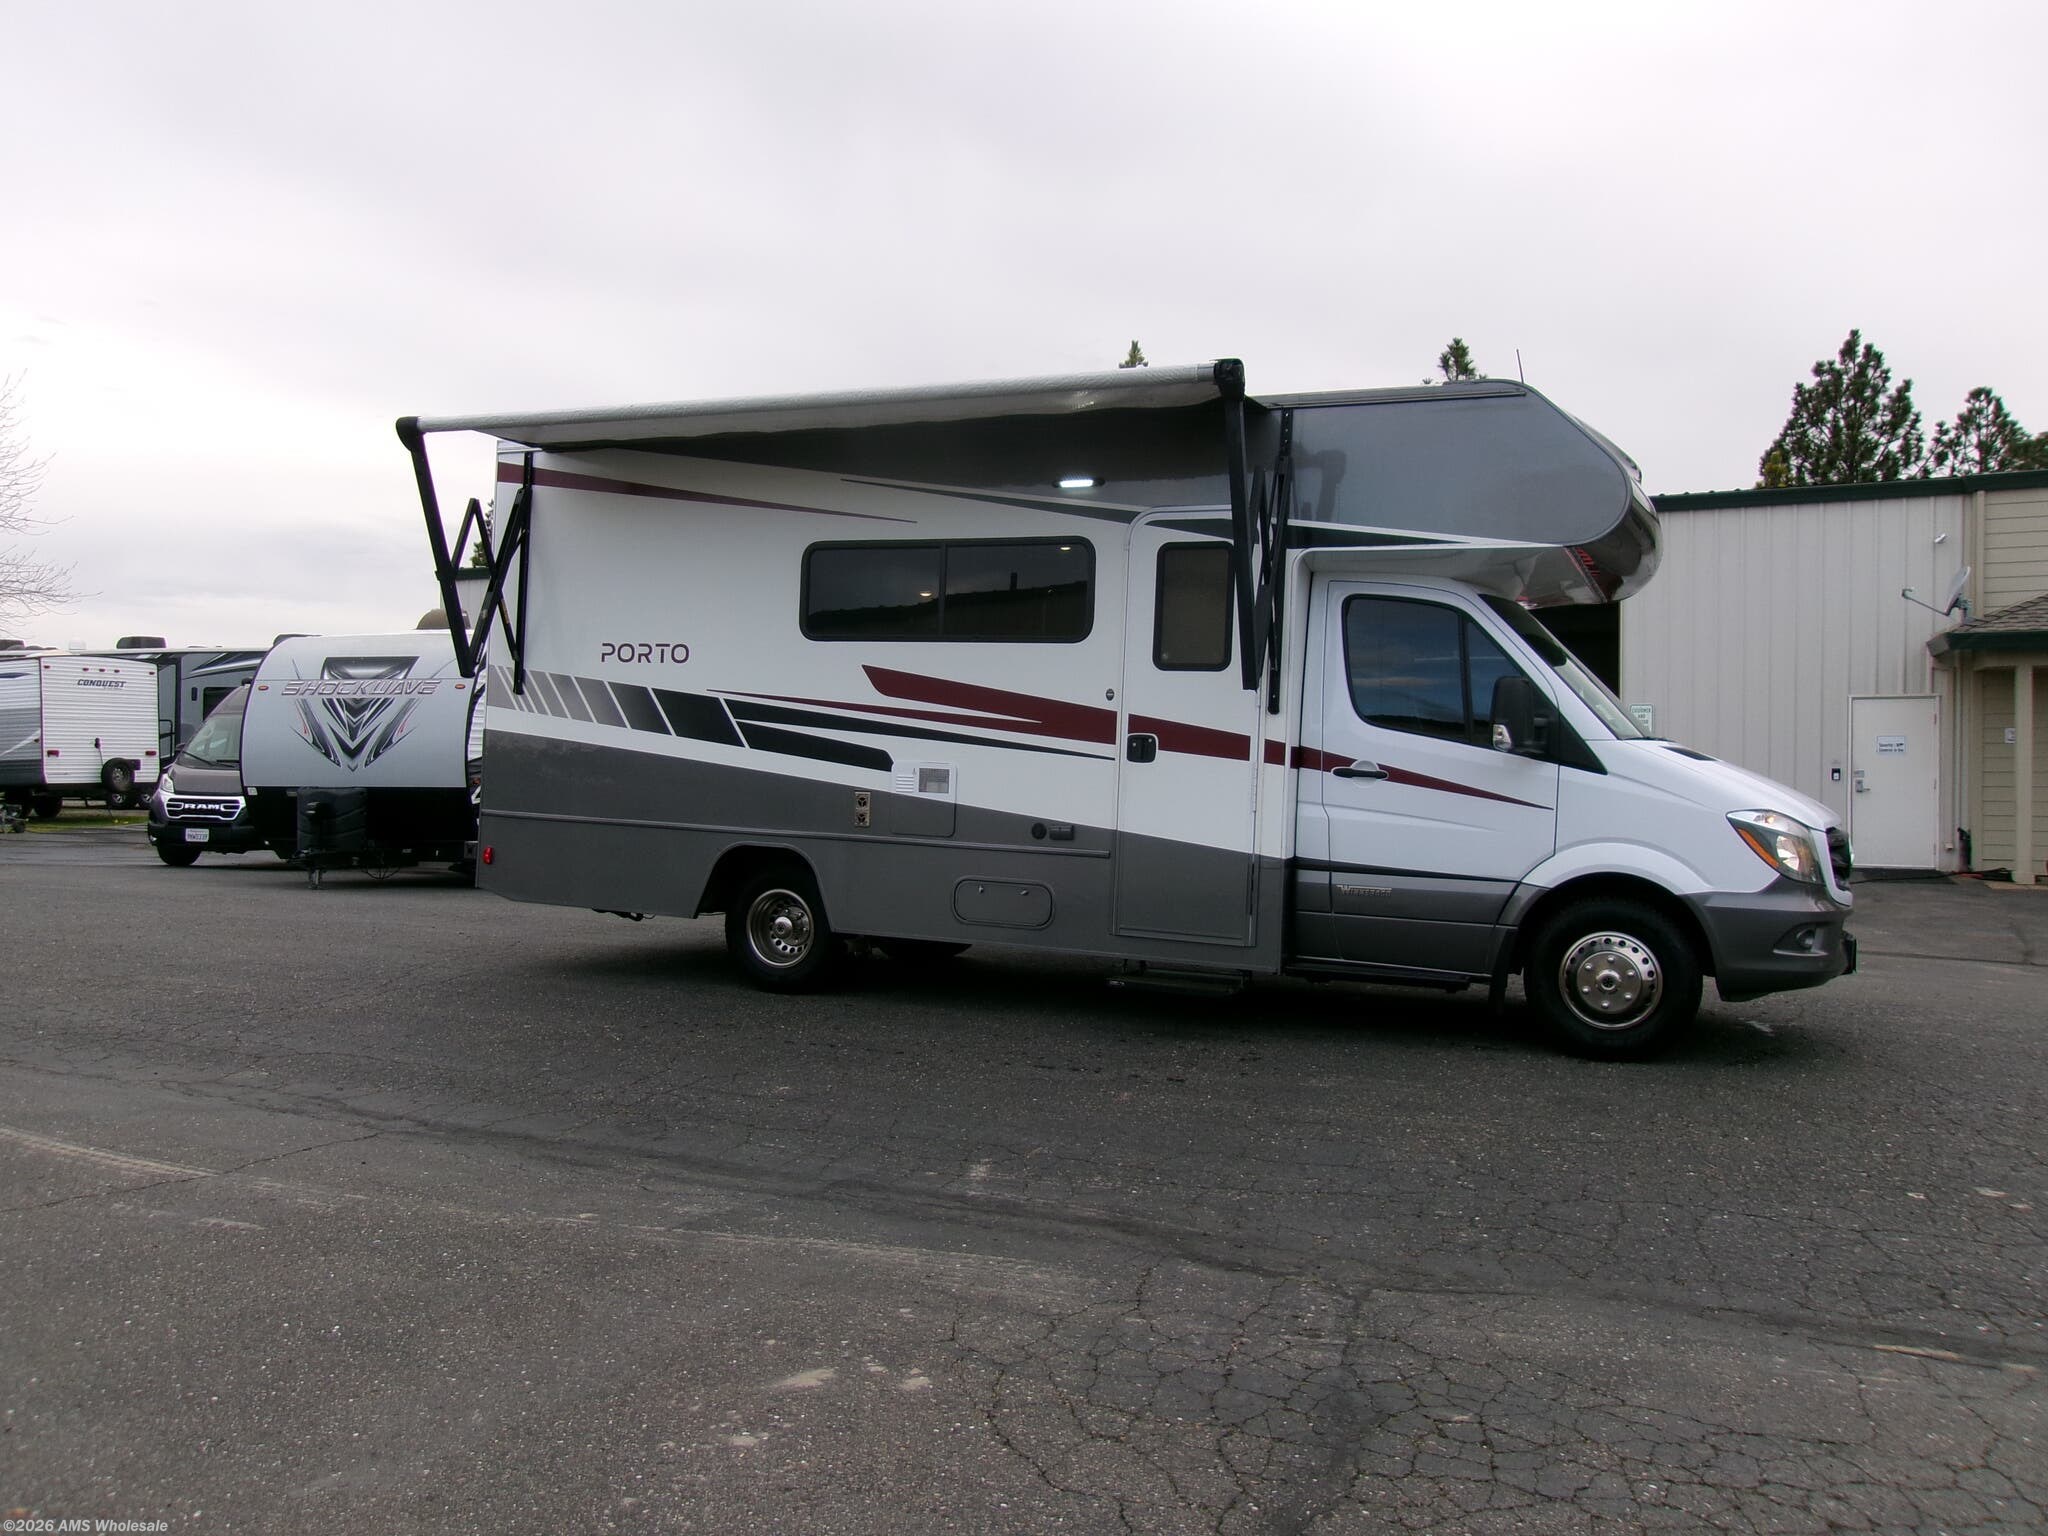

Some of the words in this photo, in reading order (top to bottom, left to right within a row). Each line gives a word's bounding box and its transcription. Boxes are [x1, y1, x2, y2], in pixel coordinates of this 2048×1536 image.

[600, 642, 690, 664] PORTO
[77, 679, 127, 688] CONQUEST
[281, 679, 441, 696] SHOCKWAVE
